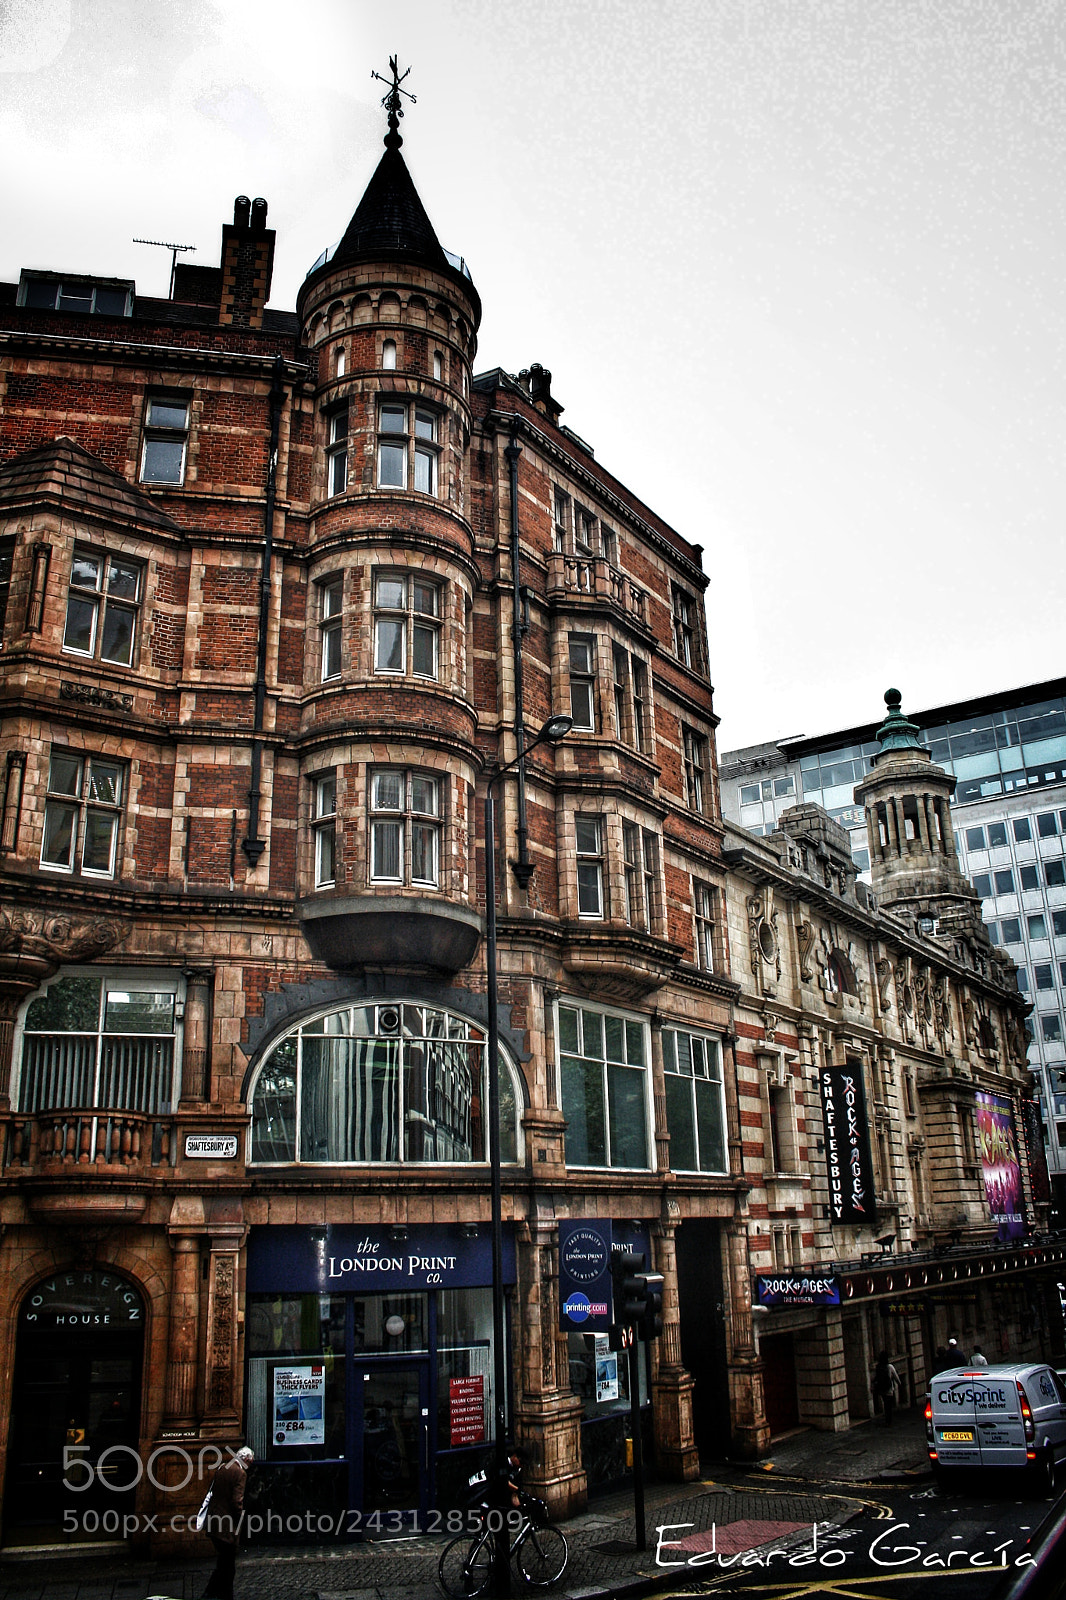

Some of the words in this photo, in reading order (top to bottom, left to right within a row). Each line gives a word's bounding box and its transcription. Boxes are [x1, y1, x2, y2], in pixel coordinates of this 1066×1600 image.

[840, 1074, 861, 1137] ROCK
[187, 1141, 225, 1151] SHAFTESBURY
[823, 1073, 843, 1218] SHAFTESBURY
[849, 1147, 865, 1213] AGES
[357, 1237, 380, 1253] the
[568, 1234, 580, 1247] FAST
[580, 1233, 602, 1247] QUALITY
[565, 1253, 587, 1261] LONDON
[587, 1253, 603, 1261] PRINT
[328, 1257, 403, 1277] LONDON
[407, 1255, 457, 1275] PRINT
[570, 1268, 599, 1279] PRINTING
[426, 1272, 443, 1284] co.
[760, 1276, 798, 1296] ROCK
[800, 1276, 835, 1296] AGES
[26, 1274, 140, 1321] SOVEREIGN
[565, 1302, 606, 1314] printing.com
[56, 1315, 110, 1325] HOUSE
[938, 1387, 1006, 1406] CitySprint
[285, 1421, 305, 1431] £84
